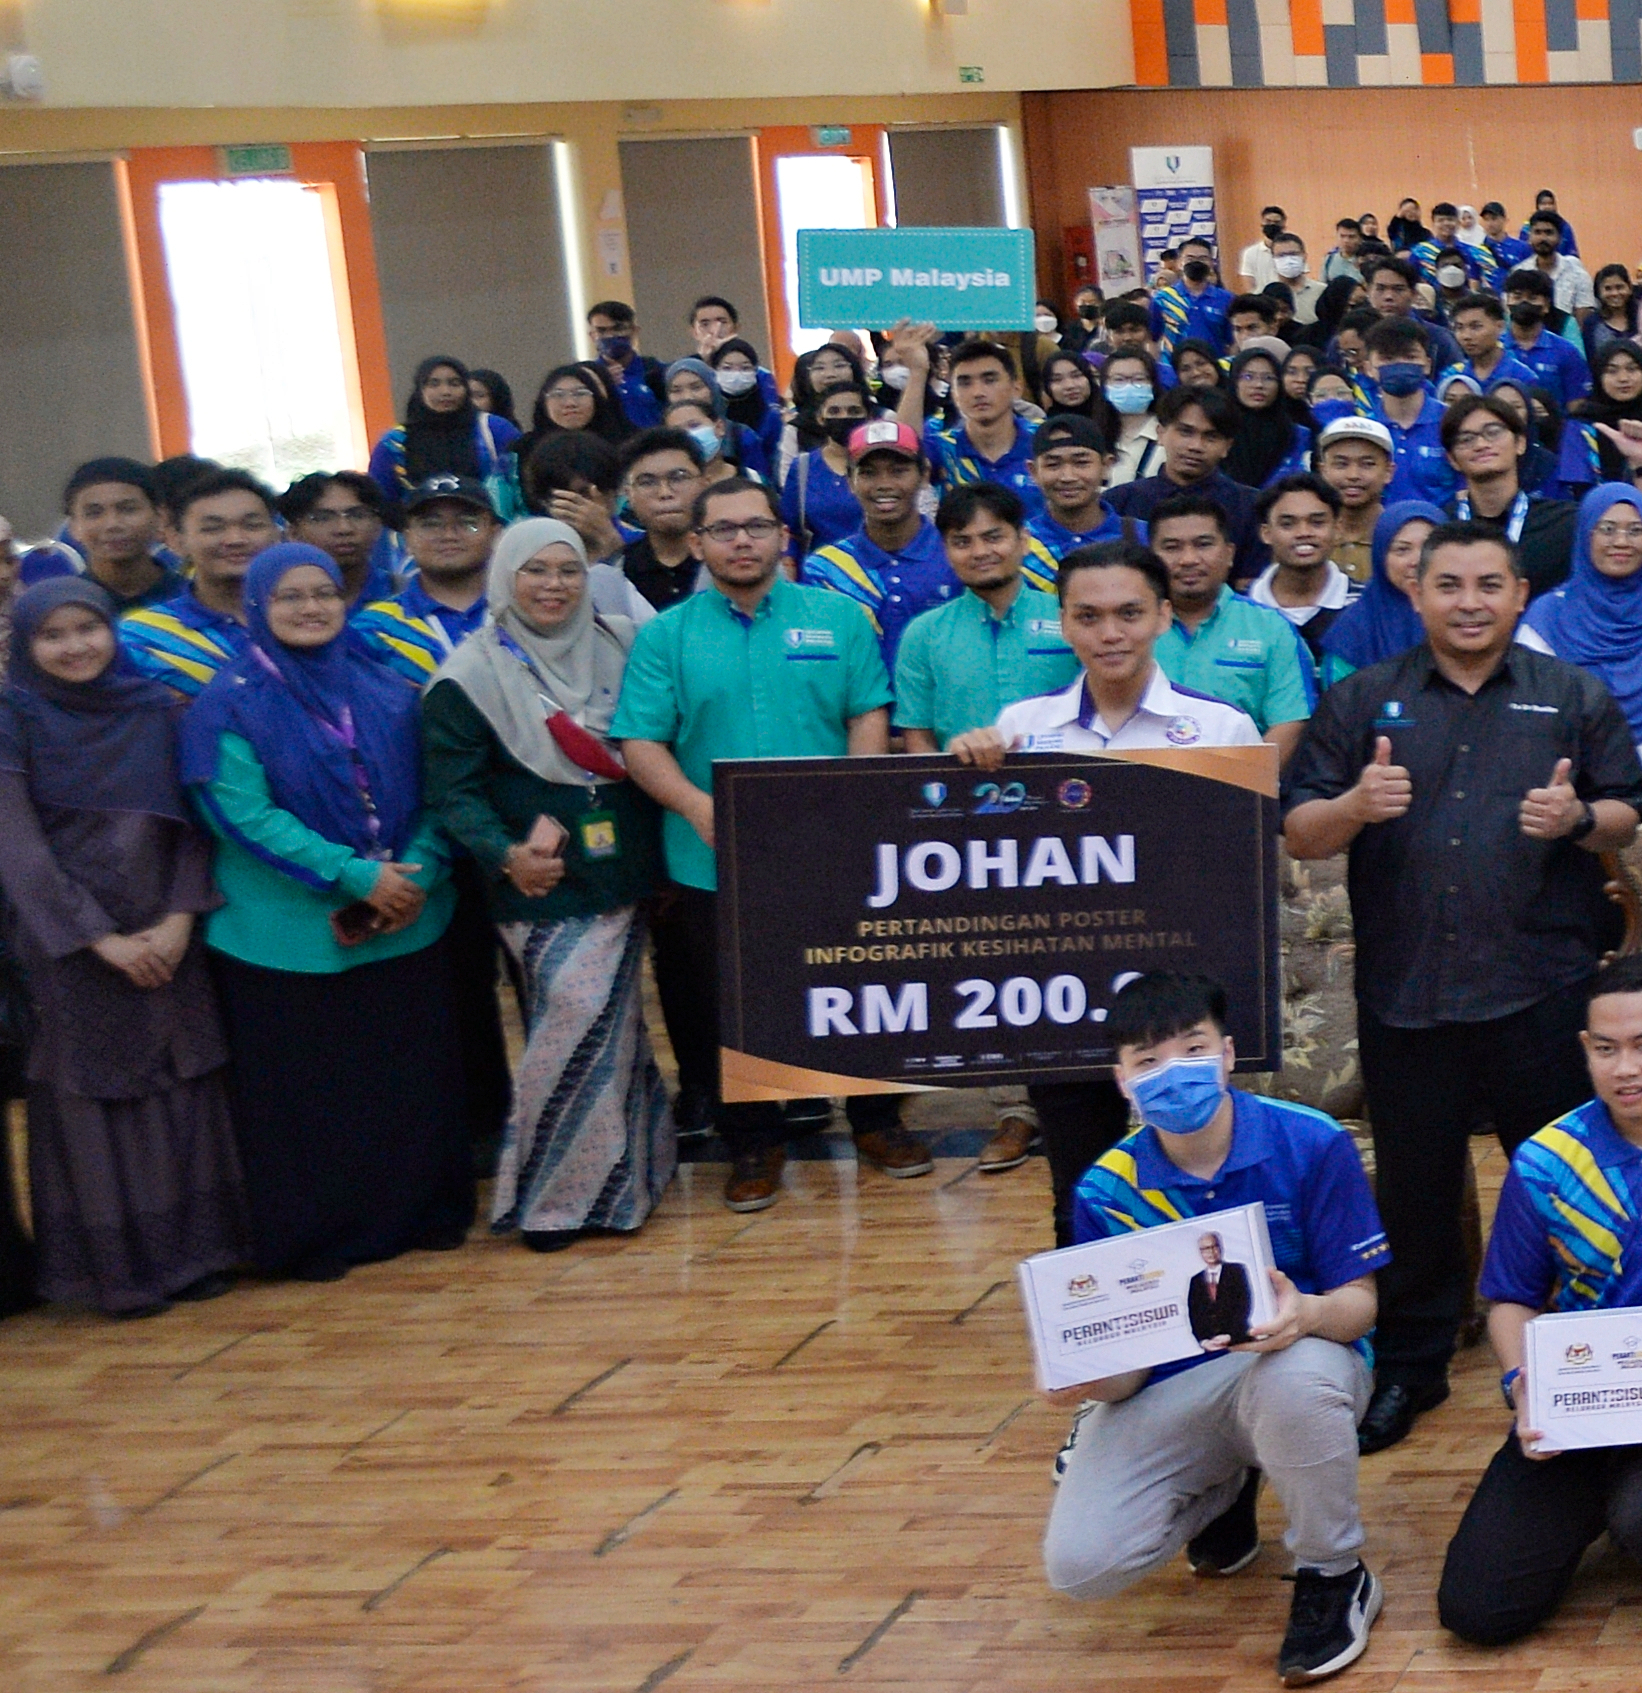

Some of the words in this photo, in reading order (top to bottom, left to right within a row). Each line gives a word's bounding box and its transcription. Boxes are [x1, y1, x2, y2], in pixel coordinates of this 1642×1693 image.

[819, 268, 883, 287] UMP
[890, 268, 1011, 291] Malaysia
[866, 834, 1137, 909] JOHAN
[857, 913, 1052, 937] PERTANDINGAN
[1058, 908, 1148, 928] POSTER
[805, 942, 955, 965] INFOGRAFIK
[961, 935, 1096, 958] KESIHATAN
[1102, 930, 1198, 950] MENTAL
[808, 981, 929, 1037] RM
[954, 971, 1145, 1029] 200.
[1063, 1303, 1179, 1343] PERANTISISWA
